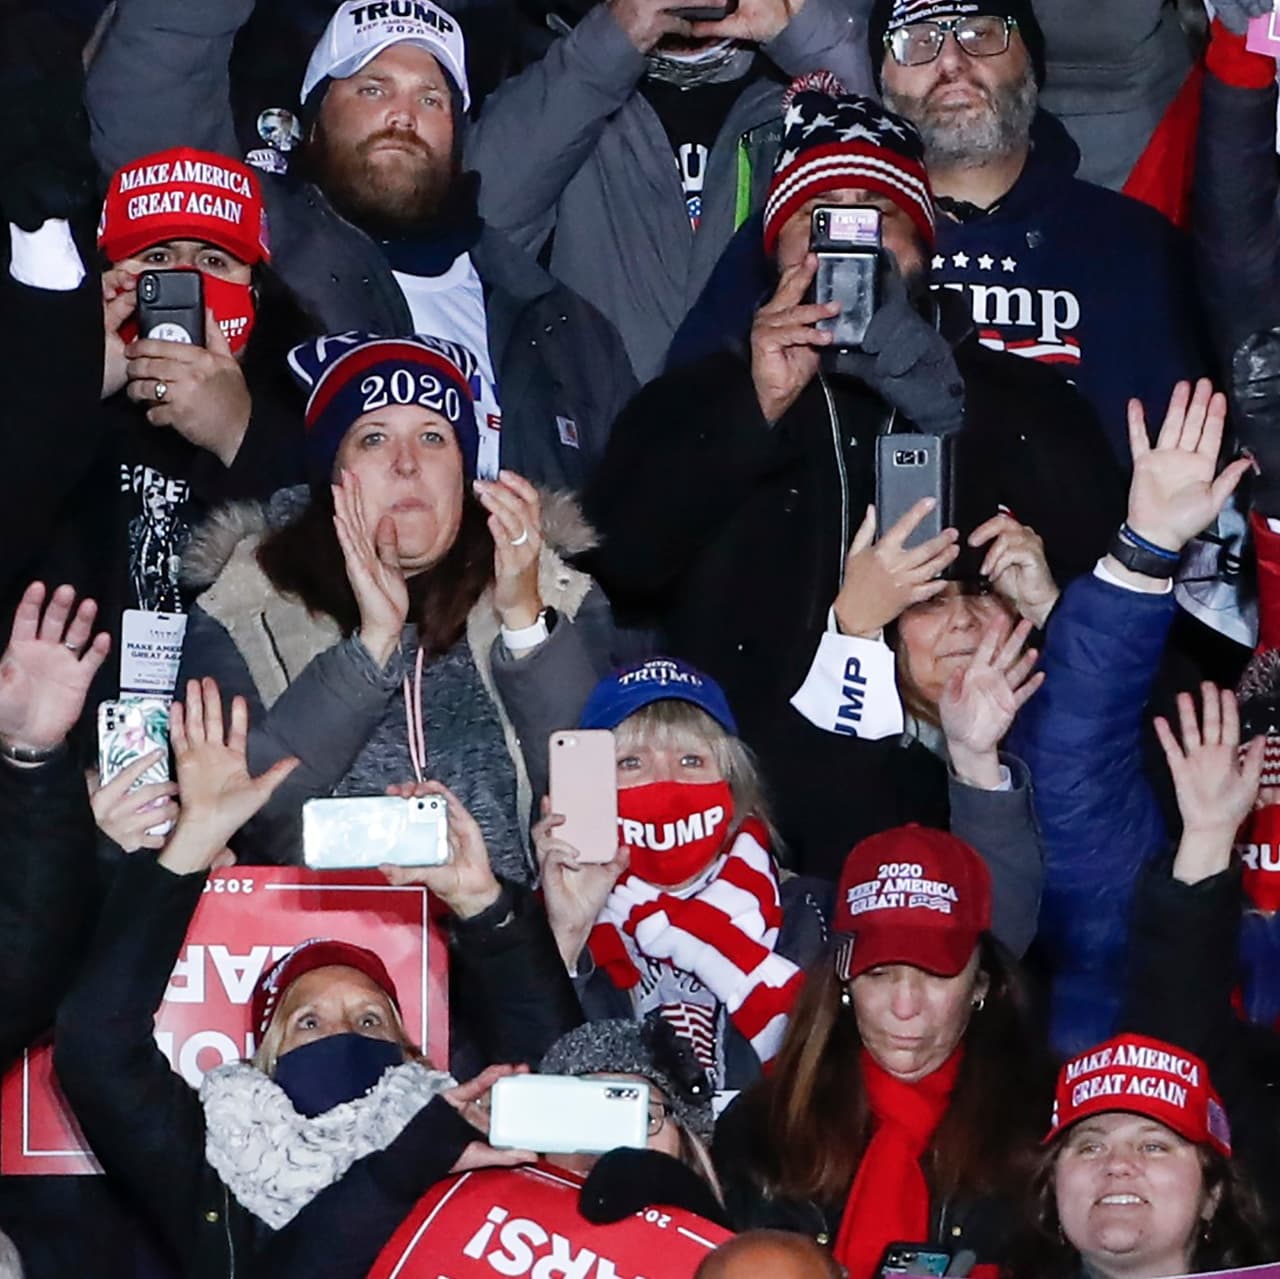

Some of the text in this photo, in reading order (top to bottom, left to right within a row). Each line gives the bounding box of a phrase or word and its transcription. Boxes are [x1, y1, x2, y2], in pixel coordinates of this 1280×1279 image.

[350, 0, 454, 34] TRUMP
[120, 160, 253, 199] MAKE AMERICA
[127, 192, 244, 225] GREAT AGAIN
[219, 317, 246, 332] UMP
[360, 369, 461, 422] 2020
[618, 667, 704, 687] TRUMP
[877, 862, 923, 879] 2020
[846, 877, 959, 902] KEEP AMERICA
[849, 892, 905, 915] GREAT!
[1064, 1044, 1199, 1087] MAKE AMERICA
[1072, 1074, 1188, 1109] GREAT AGAIN
